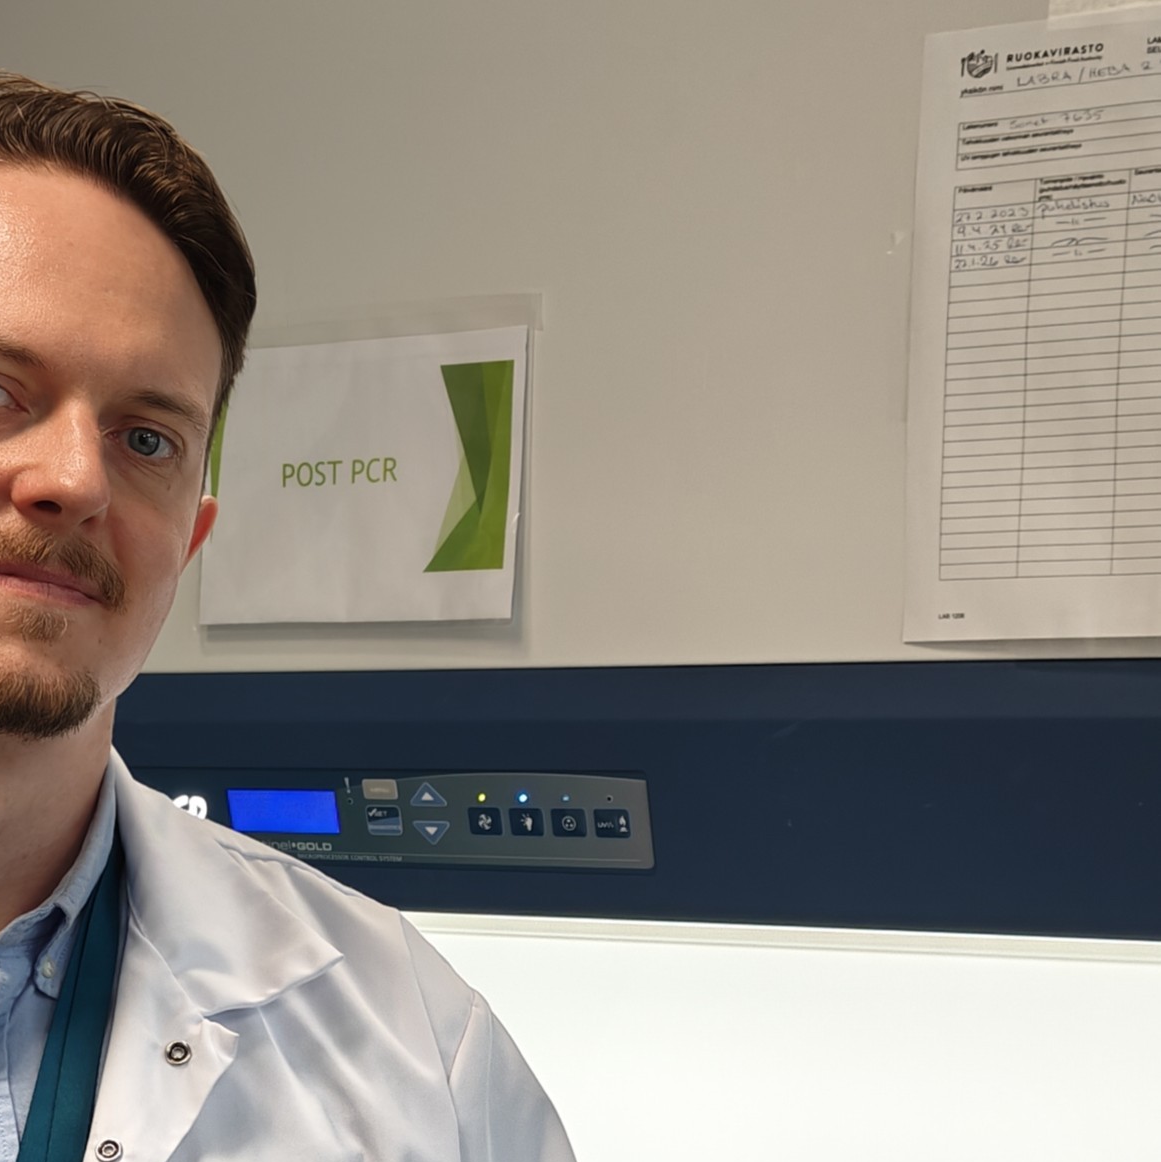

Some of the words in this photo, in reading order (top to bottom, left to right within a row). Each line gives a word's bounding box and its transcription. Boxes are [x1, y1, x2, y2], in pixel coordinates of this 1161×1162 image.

[1006, 43, 1104, 63] RUOKAVIRASTO
[282, 460, 343, 488] POST
[351, 457, 397, 484] PCR
[297, 842, 332, 852] GOLD
